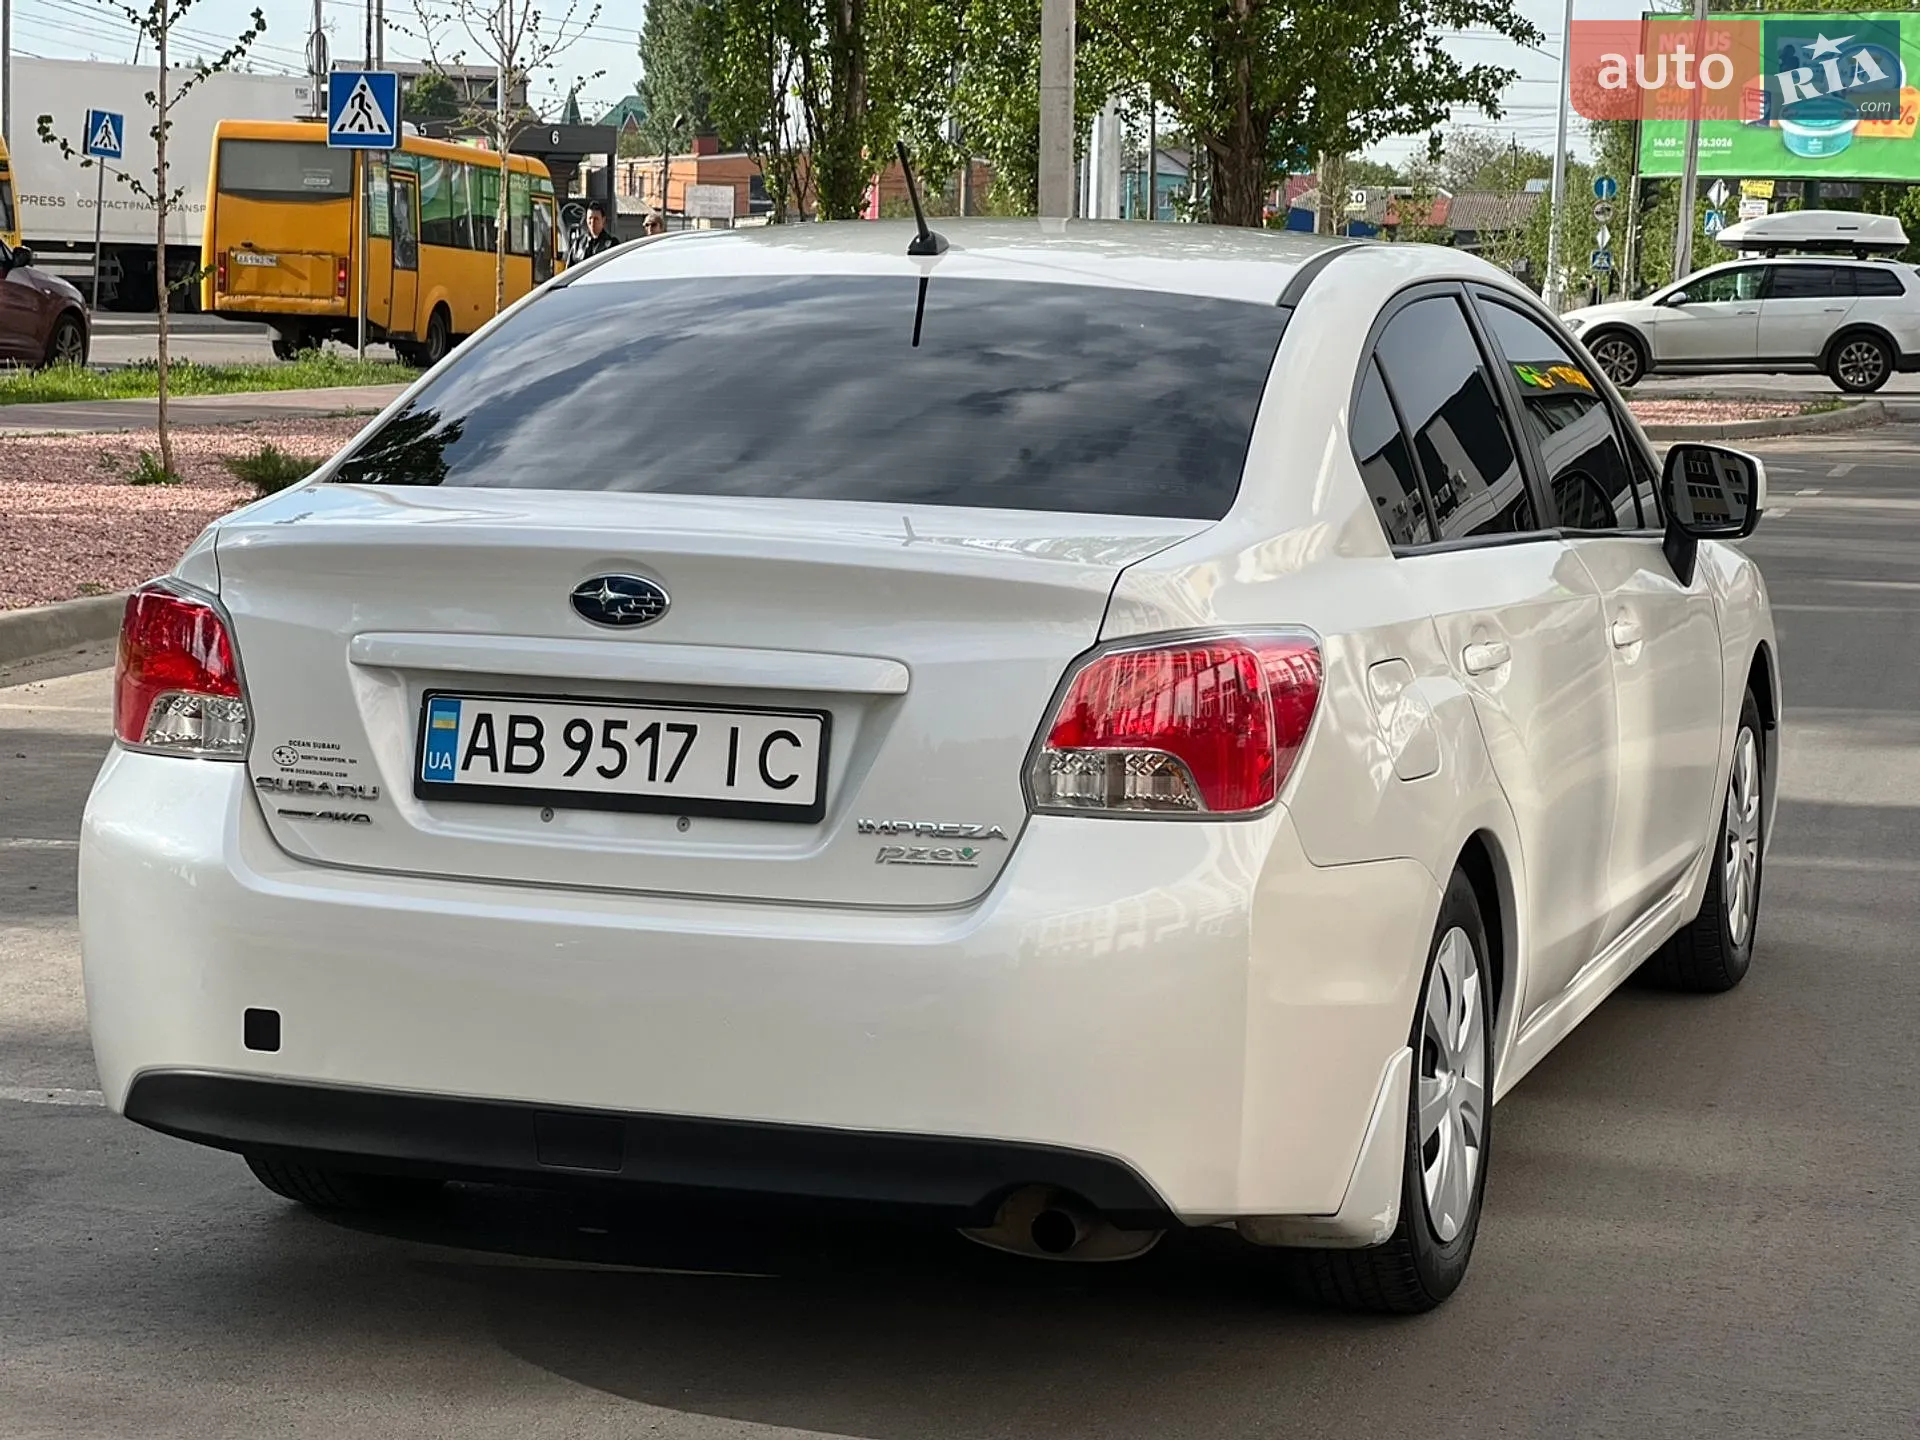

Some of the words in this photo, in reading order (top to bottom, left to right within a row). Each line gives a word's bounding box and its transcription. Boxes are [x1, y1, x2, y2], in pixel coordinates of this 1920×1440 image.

[420, 123, 427, 136] 5
[552, 131, 559, 144] 6
[289, 740, 312, 748] OCEAN
[312, 742, 340, 750] SUBARU
[461, 713, 546, 774] AB
[562, 718, 698, 783] 9517
[726, 727, 802, 790] IC
[428, 751, 452, 771] UA
[256, 777, 379, 800] SUBARU
[316, 811, 372, 824] AWD
[857, 818, 1008, 841] IMPREZA
